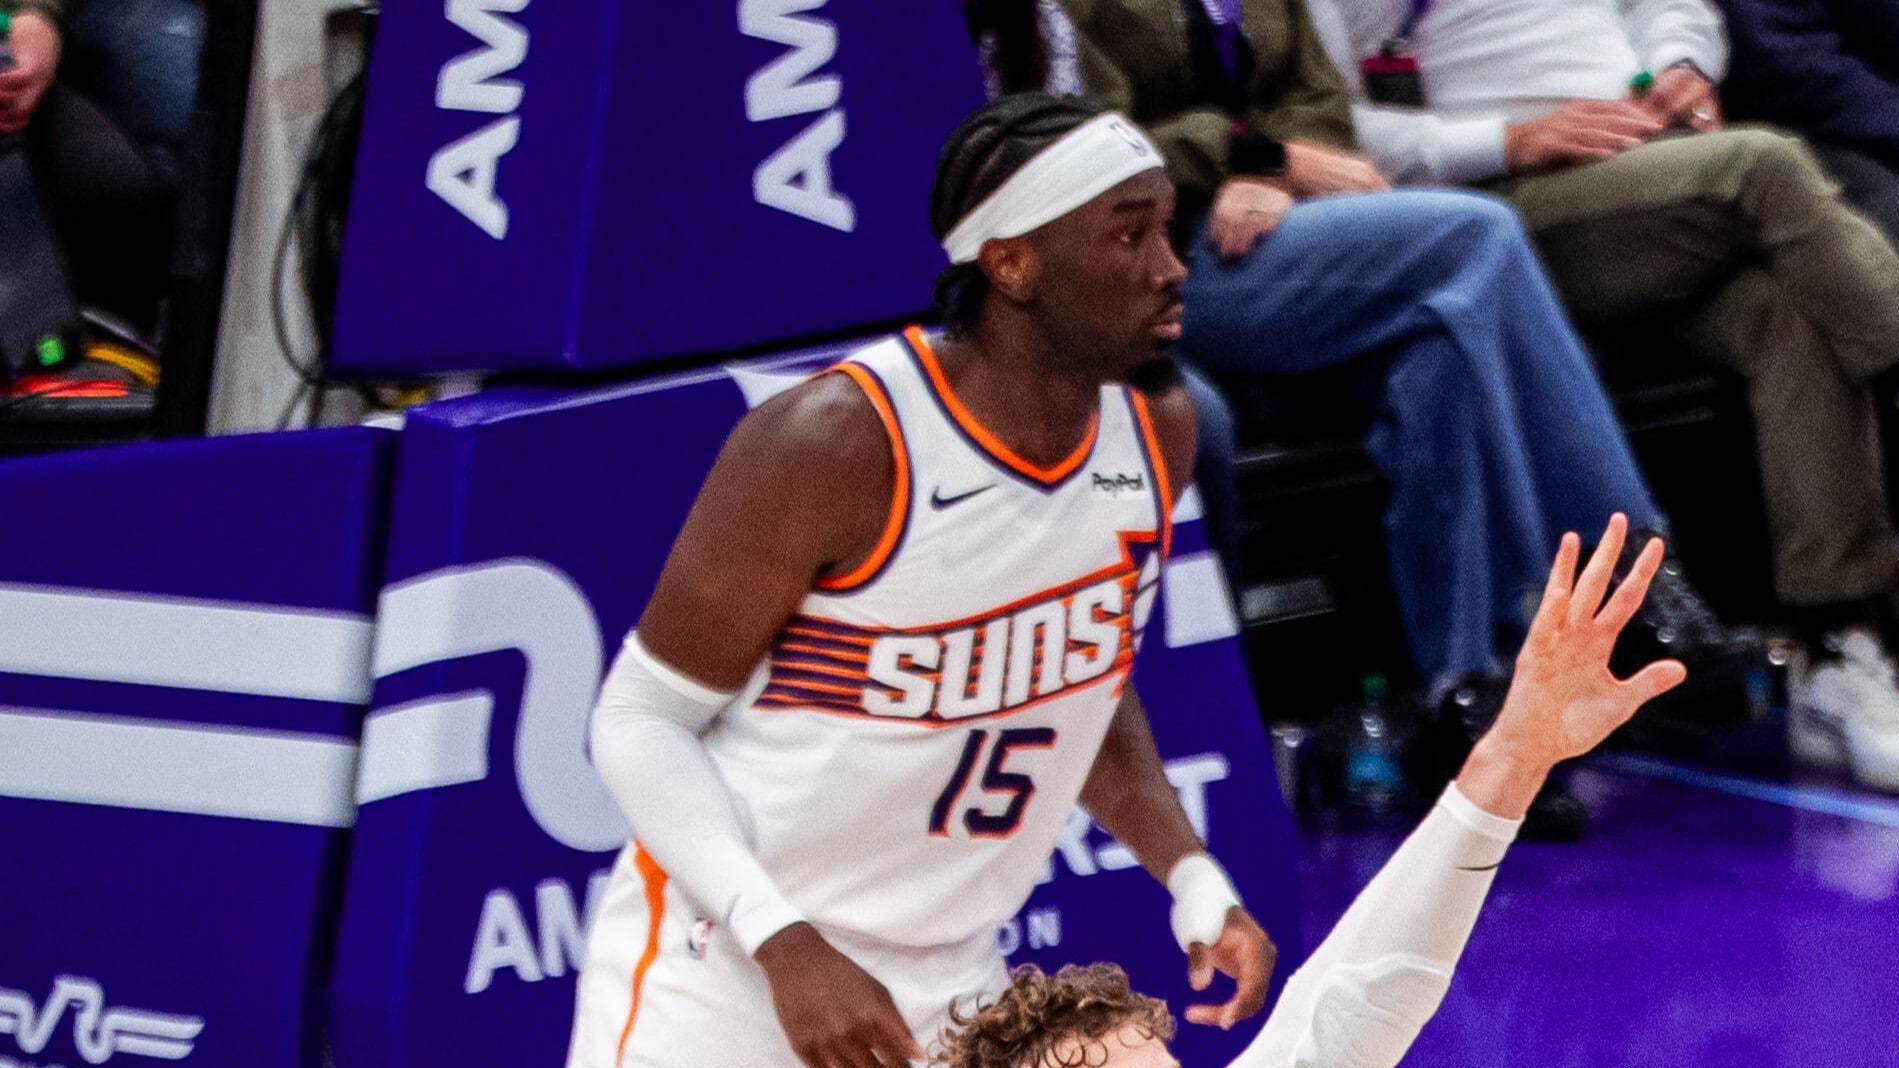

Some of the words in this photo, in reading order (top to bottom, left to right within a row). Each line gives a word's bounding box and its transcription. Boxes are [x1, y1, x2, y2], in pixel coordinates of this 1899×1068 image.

[1091, 472, 1145, 499] PayPal
[862, 577, 1123, 721] SUNS
[927, 727, 1058, 841] 15
